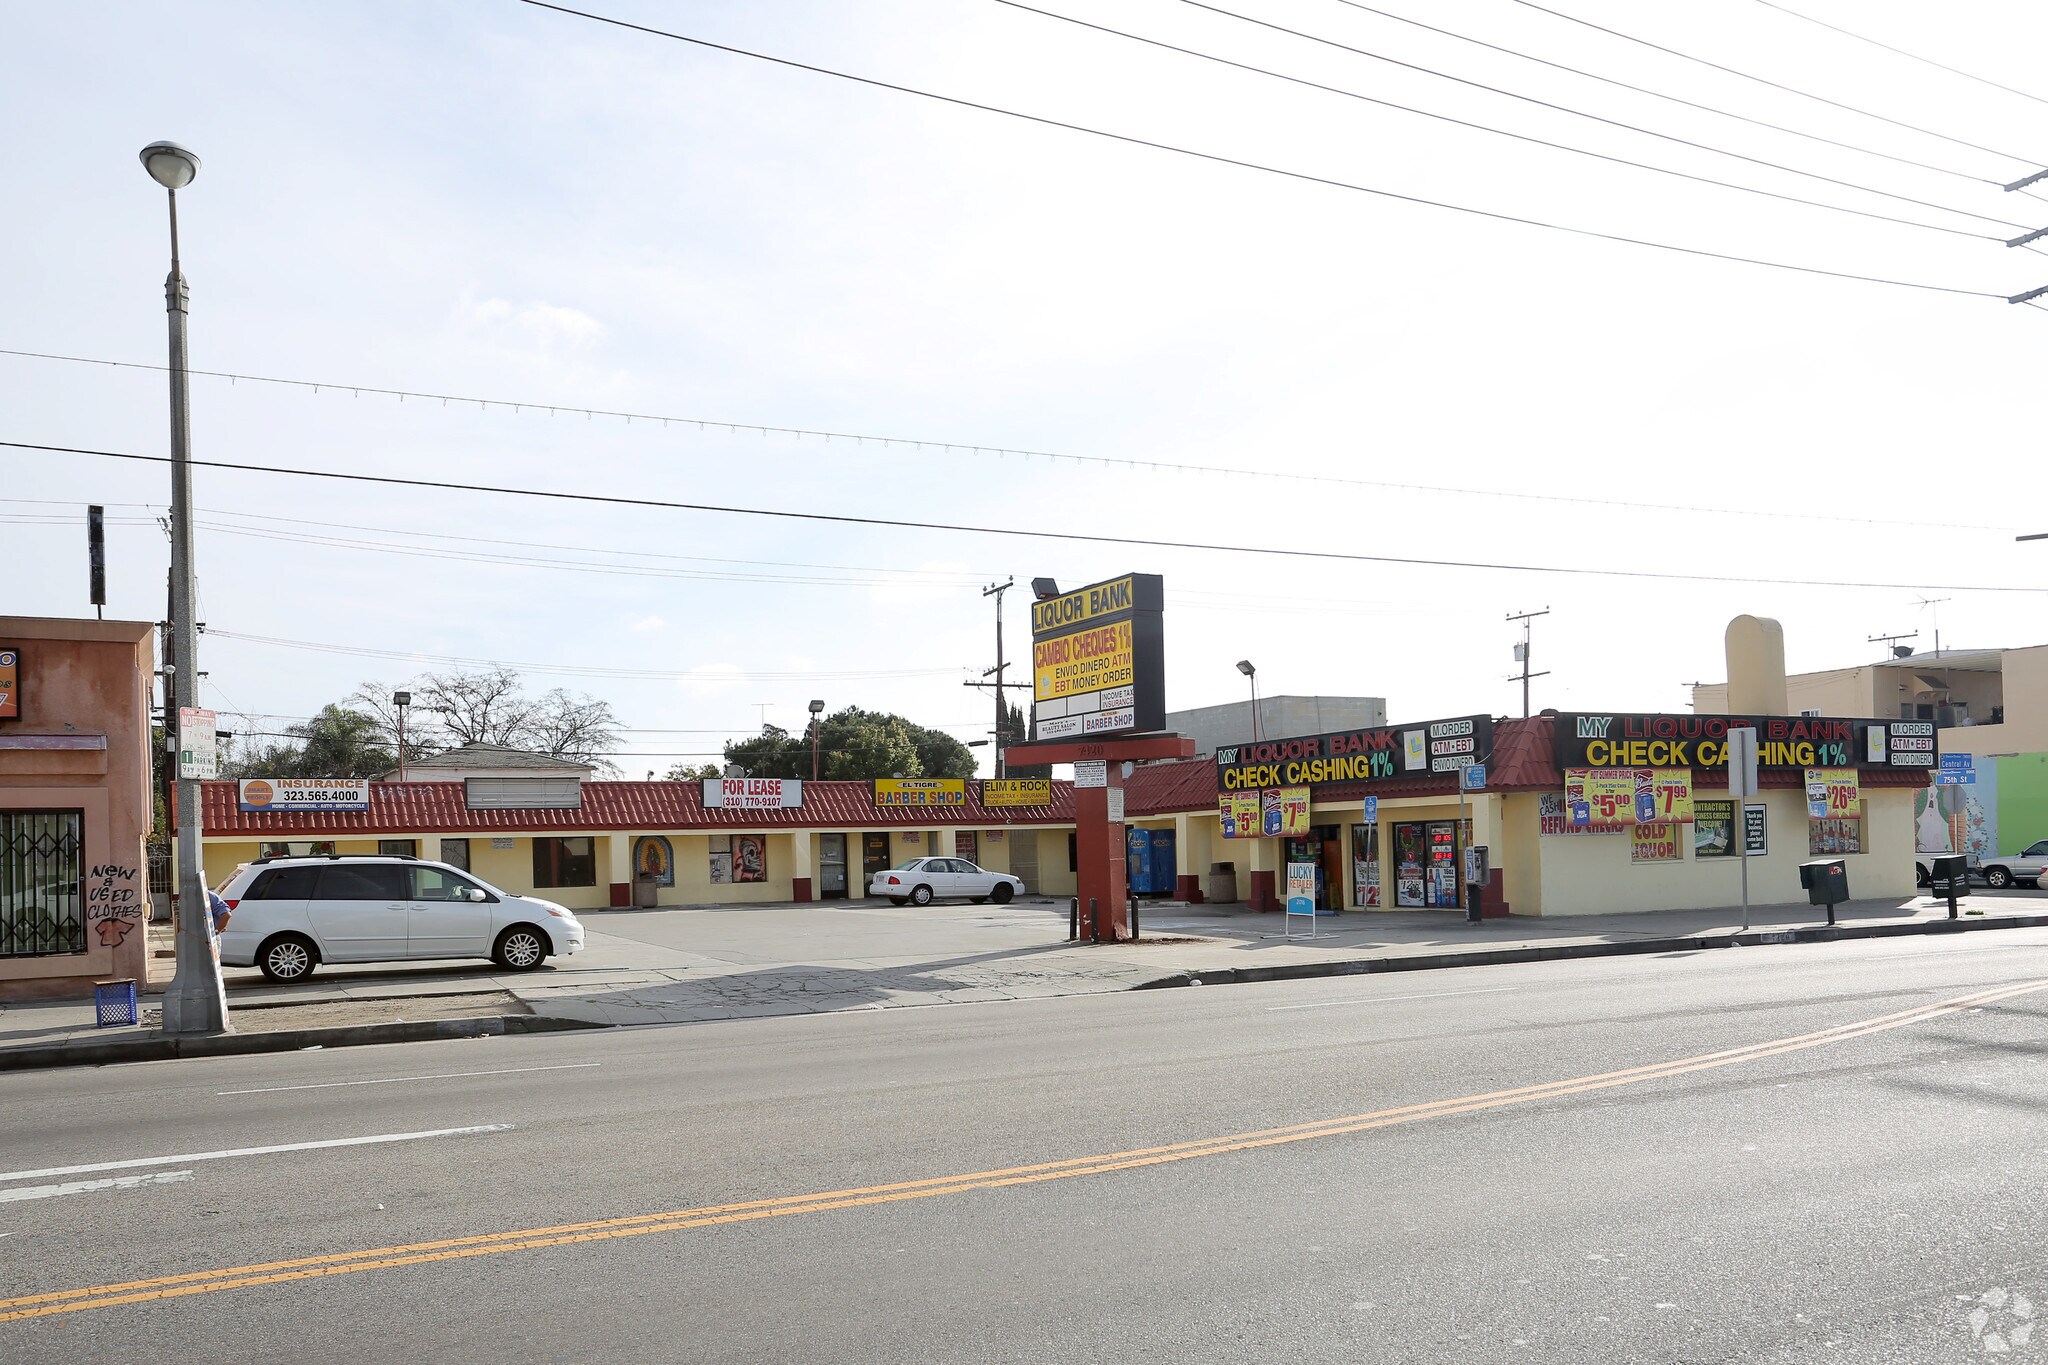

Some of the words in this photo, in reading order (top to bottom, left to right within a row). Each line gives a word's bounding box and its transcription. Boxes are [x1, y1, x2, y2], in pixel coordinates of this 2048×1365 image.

[1034, 595, 1083, 629] LIQUOR
[1090, 581, 1131, 615] BANK
[1036, 638, 1070, 669] CAMBIO
[1072, 627, 1116, 661] CHEQUES
[1056, 663, 1078, 679] ENVIO
[1081, 657, 1110, 674] DINERO
[1112, 652, 1131, 668] ATM
[1055, 679, 1071, 693] EBT
[1072, 674, 1100, 690] MONEY
[1102, 667, 1131, 684] ORDER
[1103, 690, 1123, 700] INCOME
[1103, 697, 1133, 709] INSURANCE
[181, 715, 192, 727] NO
[1087, 717, 1112, 730] BARBER
[1114, 713, 1133, 726] SHOP
[1432, 721, 1471, 736] M.ORDER
[1577, 716, 1613, 738] MY
[1768, 720, 1852, 740] BANK
[1892, 724, 1931, 734] M.ORDER
[1218, 748, 1238, 764] MY
[1241, 738, 1320, 763] LIQUOR
[1329, 729, 1398, 754] BANK
[1433, 741, 1450, 753] ATM
[1456, 739, 1472, 751] EBT
[1892, 739, 1909, 749] ATM
[1916, 739, 1931, 749] EBT
[1586, 740, 1689, 765] CHECK
[1697, 740, 1814, 765] CAHING
[1819, 742, 1847, 766] 1%
[1893, 754, 1909, 764] ENVIO
[1911, 754, 1931, 764] DINERO
[194, 757, 214, 765] PARKING
[1434, 759, 1450, 771] ENVIO
[1941, 760, 1961, 768] Central
[1224, 764, 1281, 789] CHECK
[1287, 755, 1369, 784] CASHING
[1370, 751, 1393, 777] 1%
[1599, 771, 1617, 779] SUMMER
[1619, 770, 1632, 779] PRICE
[277, 780, 364, 788] INSURANCE
[984, 782, 1007, 791] ELIM
[1010, 782, 1017, 791] &
[1020, 781, 1048, 791] ROCK
[1943, 776, 1957, 784] 75th
[1960, 775, 1967, 783] St
[722, 779, 745, 795] FOR
[748, 779, 782, 795] LEASE
[284, 791, 358, 801] 323.565.4000
[723, 797, 743, 807] (310)
[745, 797, 781, 806] 770-9107
[877, 791, 926, 804] BARBER
[929, 791, 963, 804] SHOP
[1541, 793, 1552, 806] WE
[1540, 802, 1559, 816] CASH
[1694, 803, 1730, 811] ONTRACTOR'S
[1635, 824, 1666, 840] COLD
[1632, 842, 1674, 858] IQUOR
[1289, 865, 1313, 879] LUCKY
[1289, 879, 1313, 889] RETAILER
[90, 887, 133, 902] USED
[88, 904, 142, 920] CLOTHES
